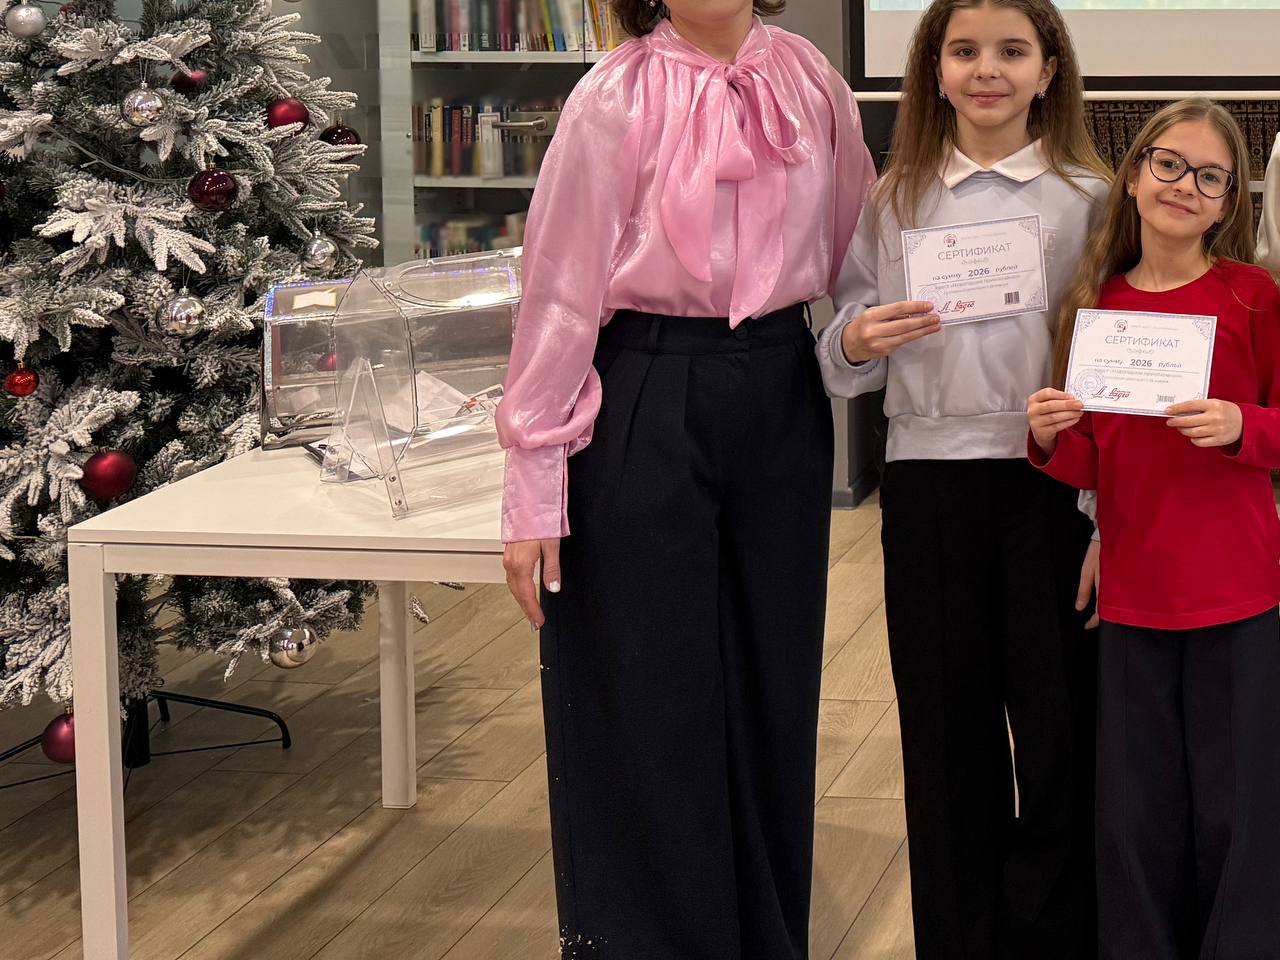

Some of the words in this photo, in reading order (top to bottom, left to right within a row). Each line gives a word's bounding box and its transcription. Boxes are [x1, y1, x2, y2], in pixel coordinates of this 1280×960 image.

[937, 242, 1012, 261] СЕРТИФИКАТ
[968, 267, 990, 278] 2026
[1104, 335, 1181, 349] СЕРТИФИКАТ
[1130, 358, 1153, 367] 2026
